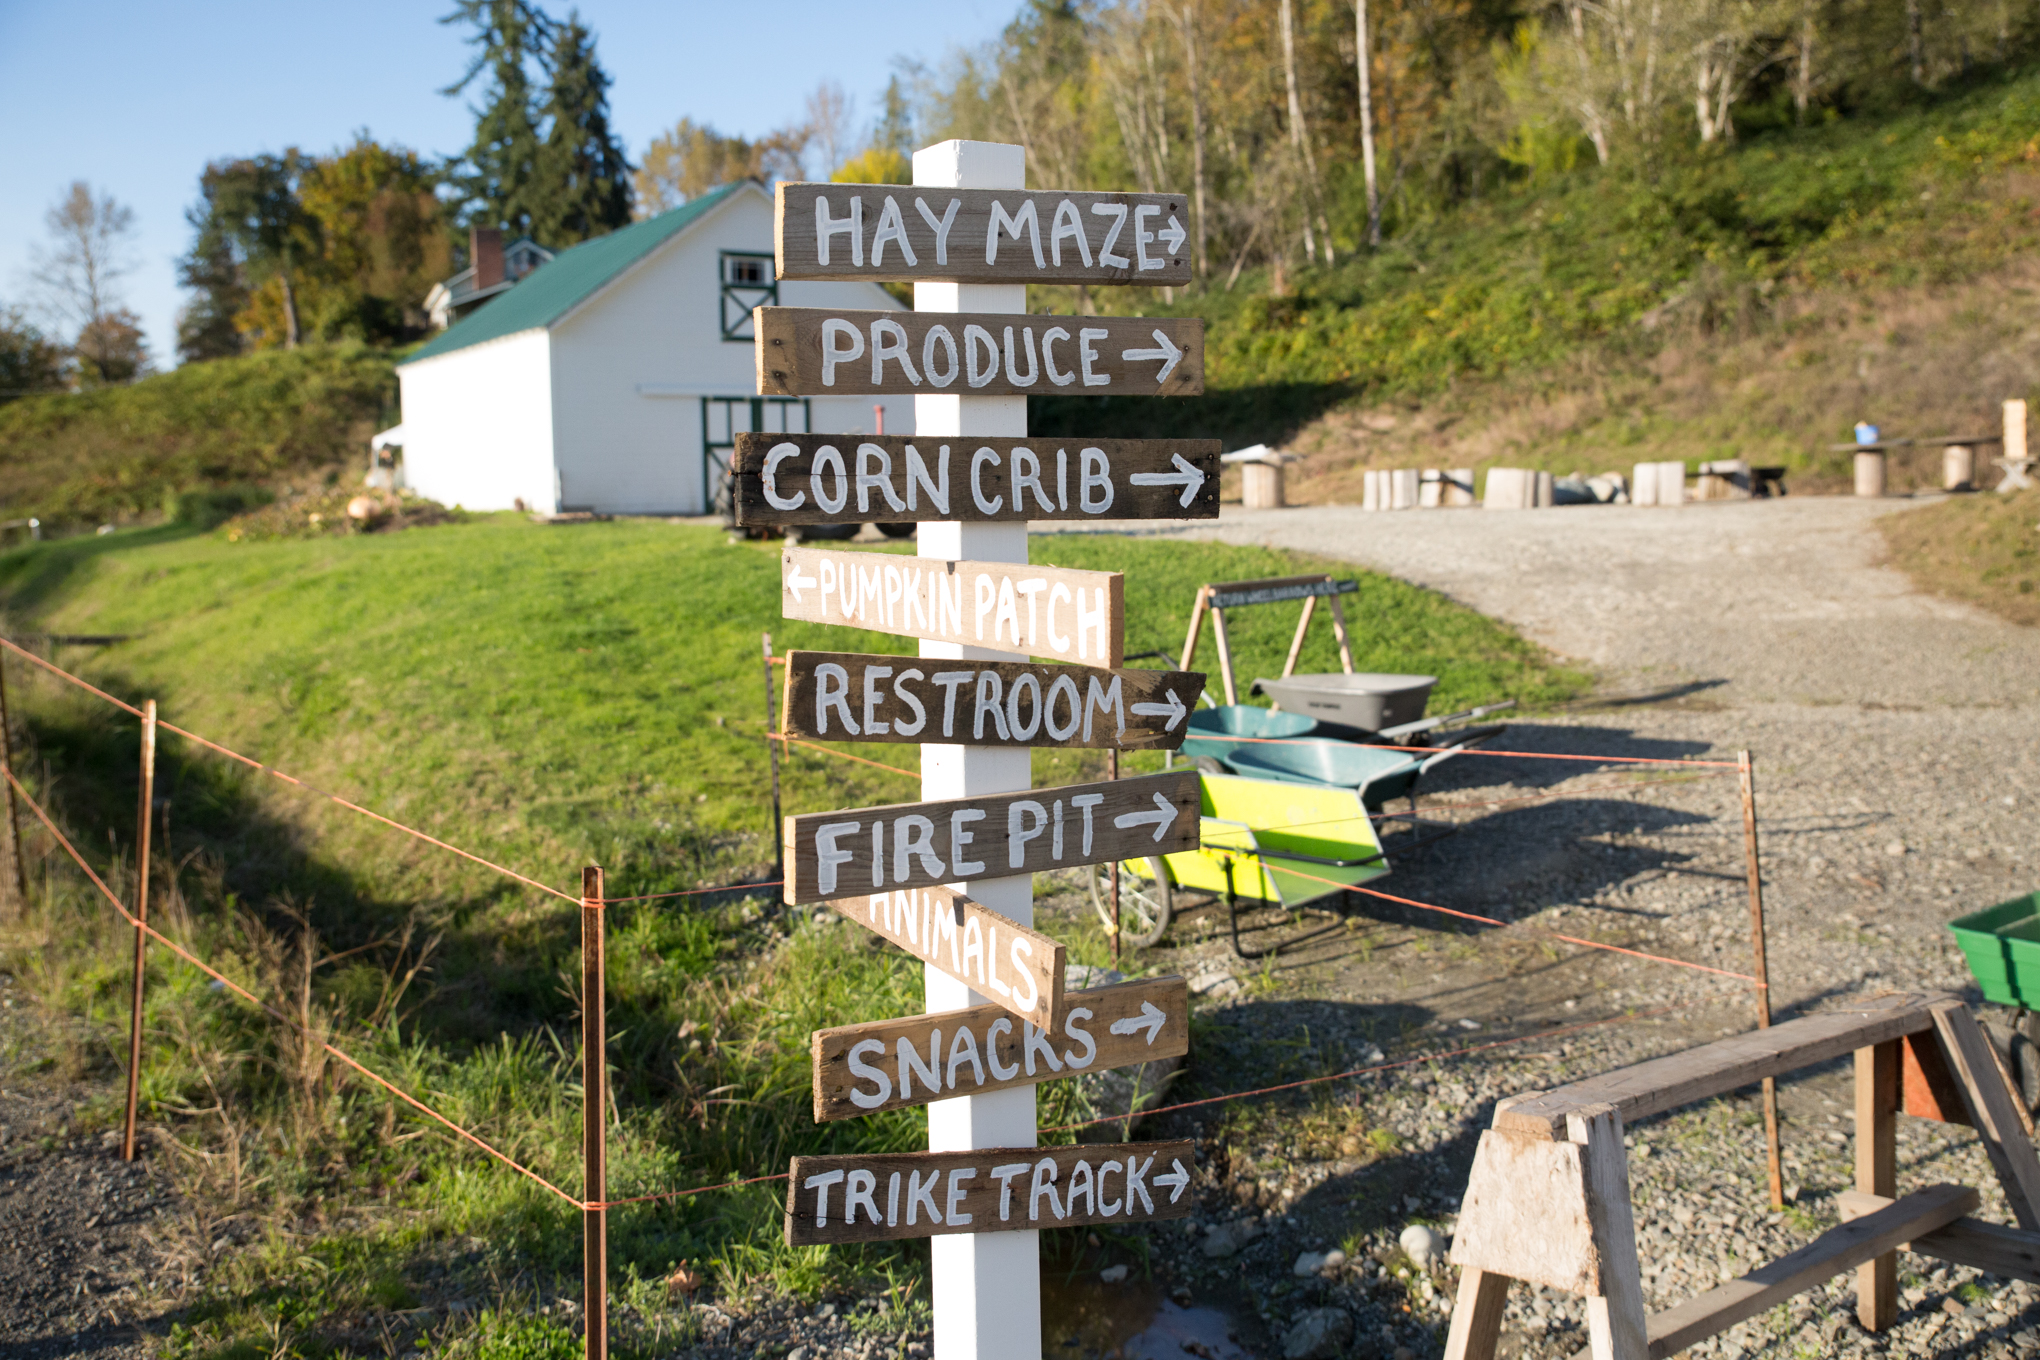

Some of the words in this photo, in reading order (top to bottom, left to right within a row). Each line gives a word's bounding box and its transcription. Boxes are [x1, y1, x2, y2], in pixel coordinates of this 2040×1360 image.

[816, 196, 961, 267] HAY
[986, 199, 1165, 271] MAZE
[822, 318, 1111, 388] PRODUCE
[762, 443, 950, 514] CORN
[971, 446, 1114, 515] CRIB
[820, 558, 962, 636] PUMPKIN
[974, 573, 1105, 659] PATCH
[814, 663, 1125, 745] RESTROOM
[815, 808, 986, 895] FIRE
[1008, 793, 1104, 868] PIT
[869, 888, 1039, 1013] ANIMALS
[848, 1007, 1096, 1109] SNACKS
[804, 1167, 976, 1228] TRIKE
[990, 1150, 1157, 1221] TRACK
